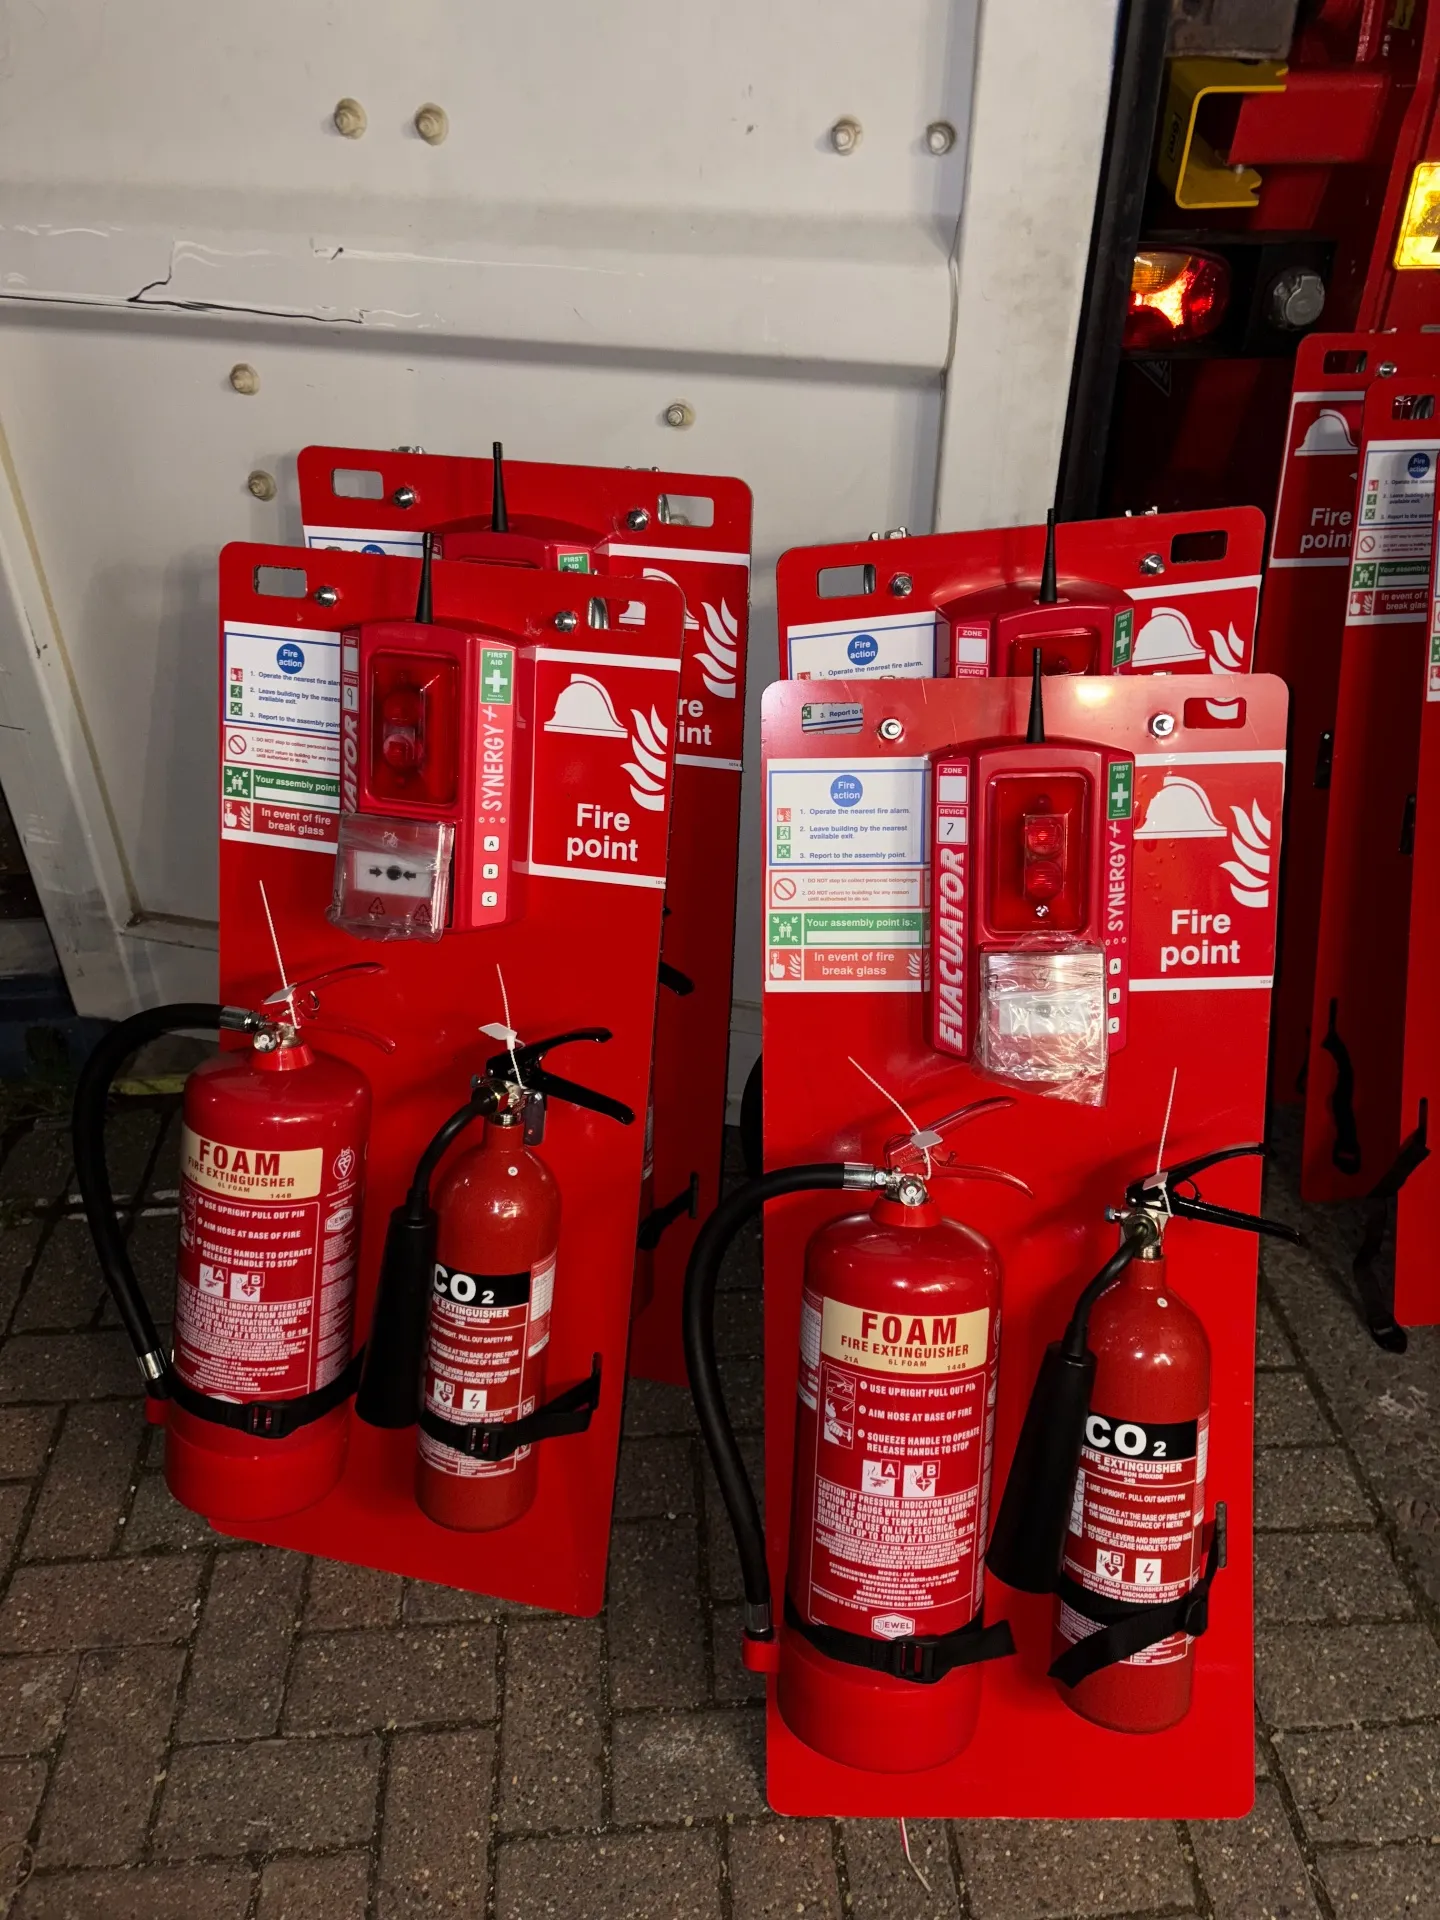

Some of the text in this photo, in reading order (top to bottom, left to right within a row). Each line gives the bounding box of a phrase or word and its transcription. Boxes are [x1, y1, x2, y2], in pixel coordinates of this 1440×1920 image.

[1311, 508, 1351, 526] Fire
[1118, 613, 1130, 622] FIRST
[854, 641, 871, 649] Fire
[283, 649, 298, 658] Fire
[850, 650, 875, 659] action
[279, 659, 302, 667] action
[828, 668, 853, 677] Operate
[678, 699, 703, 717] re
[829, 710, 850, 718] Report
[679, 721, 712, 745] int
[256, 775, 336, 792] Your assembly point
[262, 808, 331, 825] In event of fire
[576, 803, 630, 831] Fire
[268, 820, 324, 835] break glass
[946, 823, 954, 835] 7
[567, 836, 638, 862] point
[807, 919, 828, 927] Your
[831, 919, 873, 928] assembly
[877, 919, 899, 928] point
[1171, 909, 1231, 935] Fire
[939, 847, 964, 1050] EVACUATOR
[1160, 940, 1240, 972] point
[815, 952, 894, 961] In event of fire
[822, 966, 886, 976] break glass
[200, 1140, 280, 1176] FOAM
[188, 1157, 204, 1173] FIRE
[206, 1168, 295, 1187] EXTINGUISHER
[228, 1184, 250, 1193] FOAM
[205, 1202, 304, 1219] USE UPRIGHT PULL OUT PIN
[204, 1221, 215, 1232] AIM
[217, 1226, 235, 1236] HOSE
[238, 1229, 247, 1238] AT
[249, 1230, 268, 1239] BASE
[203, 1241, 232, 1255] SQUEEZE
[234, 1249, 264, 1259] HANDLE
[278, 1248, 312, 1259] OPERATE
[202, 1252, 298, 1268] RELEASE HANDLE TO STOP
[215, 1270, 224, 1280] A
[251, 1276, 261, 1284] B
[441, 1300, 509, 1318] EXTINGUISHER
[861, 1311, 957, 1345] FOAM
[841, 1335, 968, 1359] FIRE EXTINGUISHER
[844, 1354, 859, 1364] 21A
[947, 1363, 966, 1371] 144B
[870, 1383, 975, 1398] USE UPRIGHT PULL OUT PIN
[869, 1407, 972, 1422] AIM HOSE AT BASE OF FIRE
[867, 1427, 979, 1445] SQUEEZE HANDLE TO OPERATE
[867, 1441, 969, 1456] RELEASE HANDLE TO STOP
[1082, 1448, 1182, 1473] FIRE EXTINGUISHER
[885, 1464, 895, 1475] A
[927, 1464, 936, 1475] B
[859, 1495, 942, 1509] PRESSURE INDICATOR
[885, 1505, 949, 1518] WITHDRAW FROM
[892, 1516, 945, 1526] TEMPERATURE
